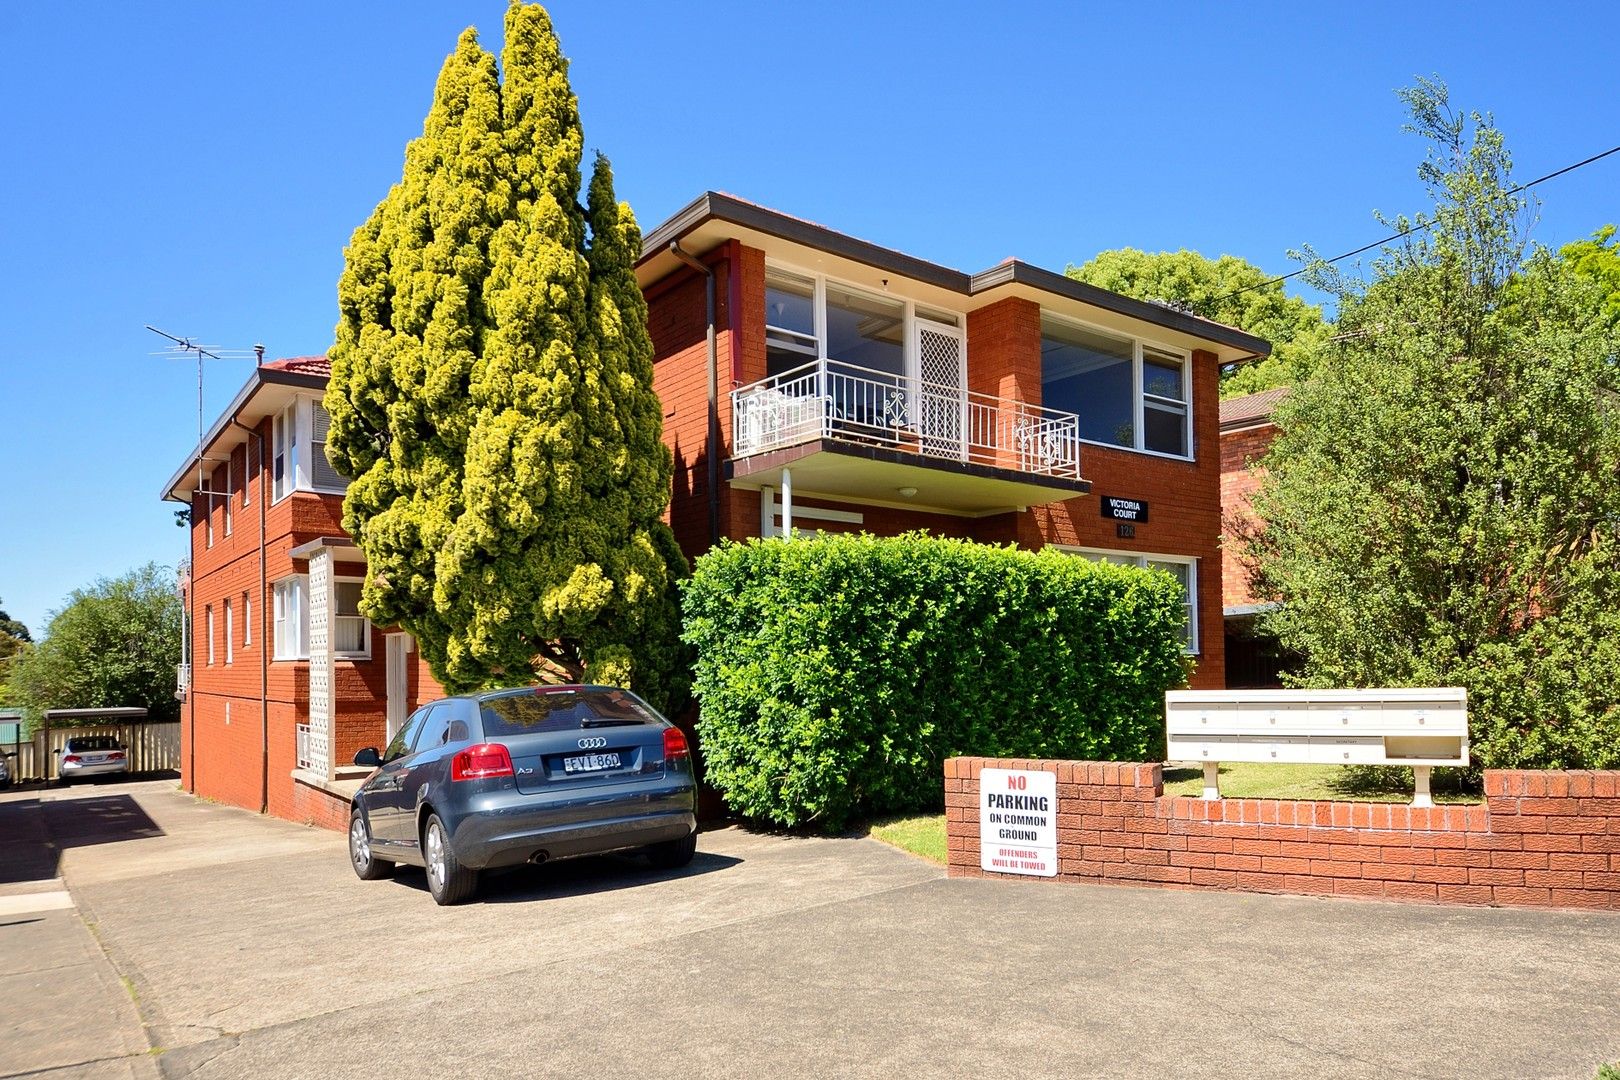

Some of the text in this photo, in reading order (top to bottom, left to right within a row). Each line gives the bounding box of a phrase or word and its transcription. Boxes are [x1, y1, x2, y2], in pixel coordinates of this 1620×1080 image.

[1110, 499, 1140, 510] VICTORIA
[1113, 509, 1137, 519] COURT
[1008, 775, 1027, 790] NO
[988, 793, 1048, 812] PARKING
[989, 813, 1047, 827] ON COMMON
[999, 828, 1037, 841] GROUND
[999, 848, 1038, 859] OFFENDERS
[992, 858, 1046, 871] WILL BE TOWED
